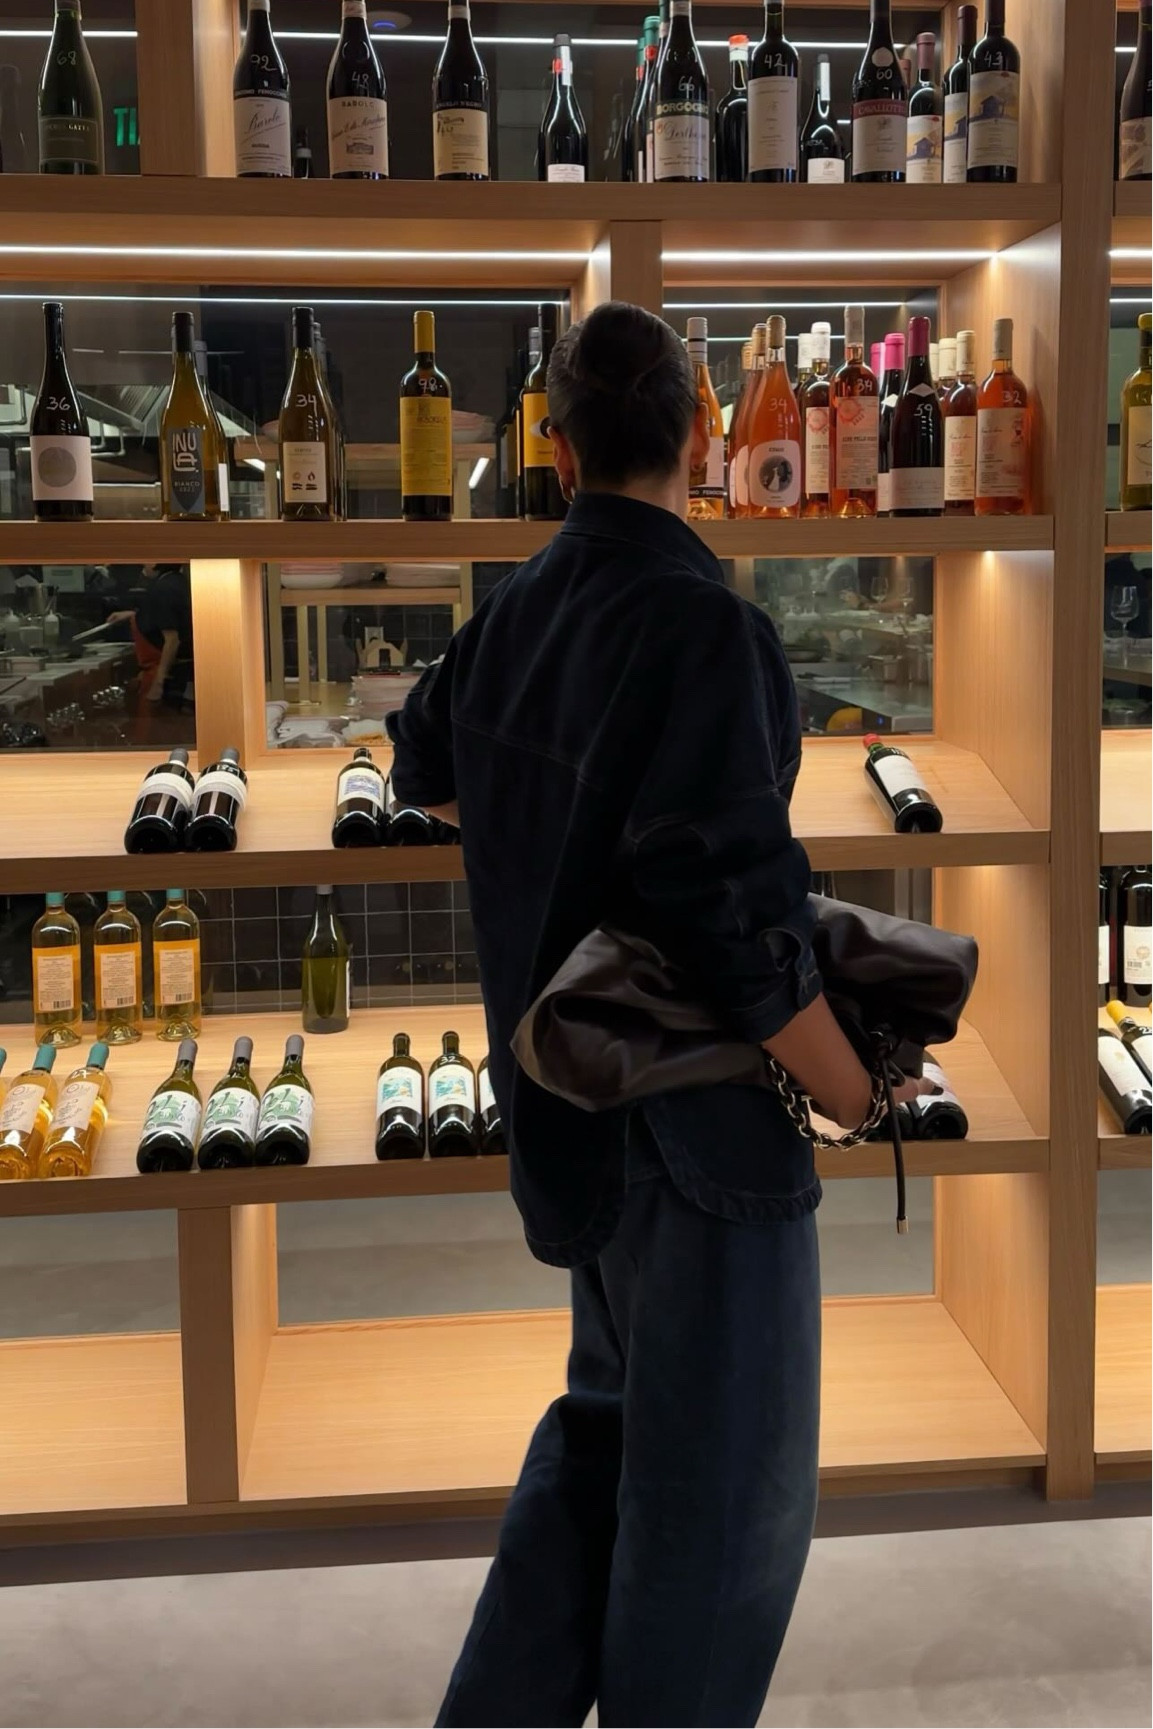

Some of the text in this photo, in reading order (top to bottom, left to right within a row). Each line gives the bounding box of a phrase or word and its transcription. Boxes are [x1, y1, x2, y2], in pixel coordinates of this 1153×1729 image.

[57, 51, 77, 65] 68
[250, 54, 277, 71] 92
[764, 53, 786, 69] 42
[983, 51, 1003, 68] 43
[351, 71, 370, 88] 48
[876, 68, 893, 80] 60
[678, 75, 696, 92] 66
[857, 379, 873, 392] 34
[46, 397, 71, 411] 36
[295, 394, 317, 408] 34
[1002, 390, 1022, 405] 32
[769, 398, 788, 412] 34
[914, 403, 934, 418] 59
[439, 1055, 462, 1066] 32
